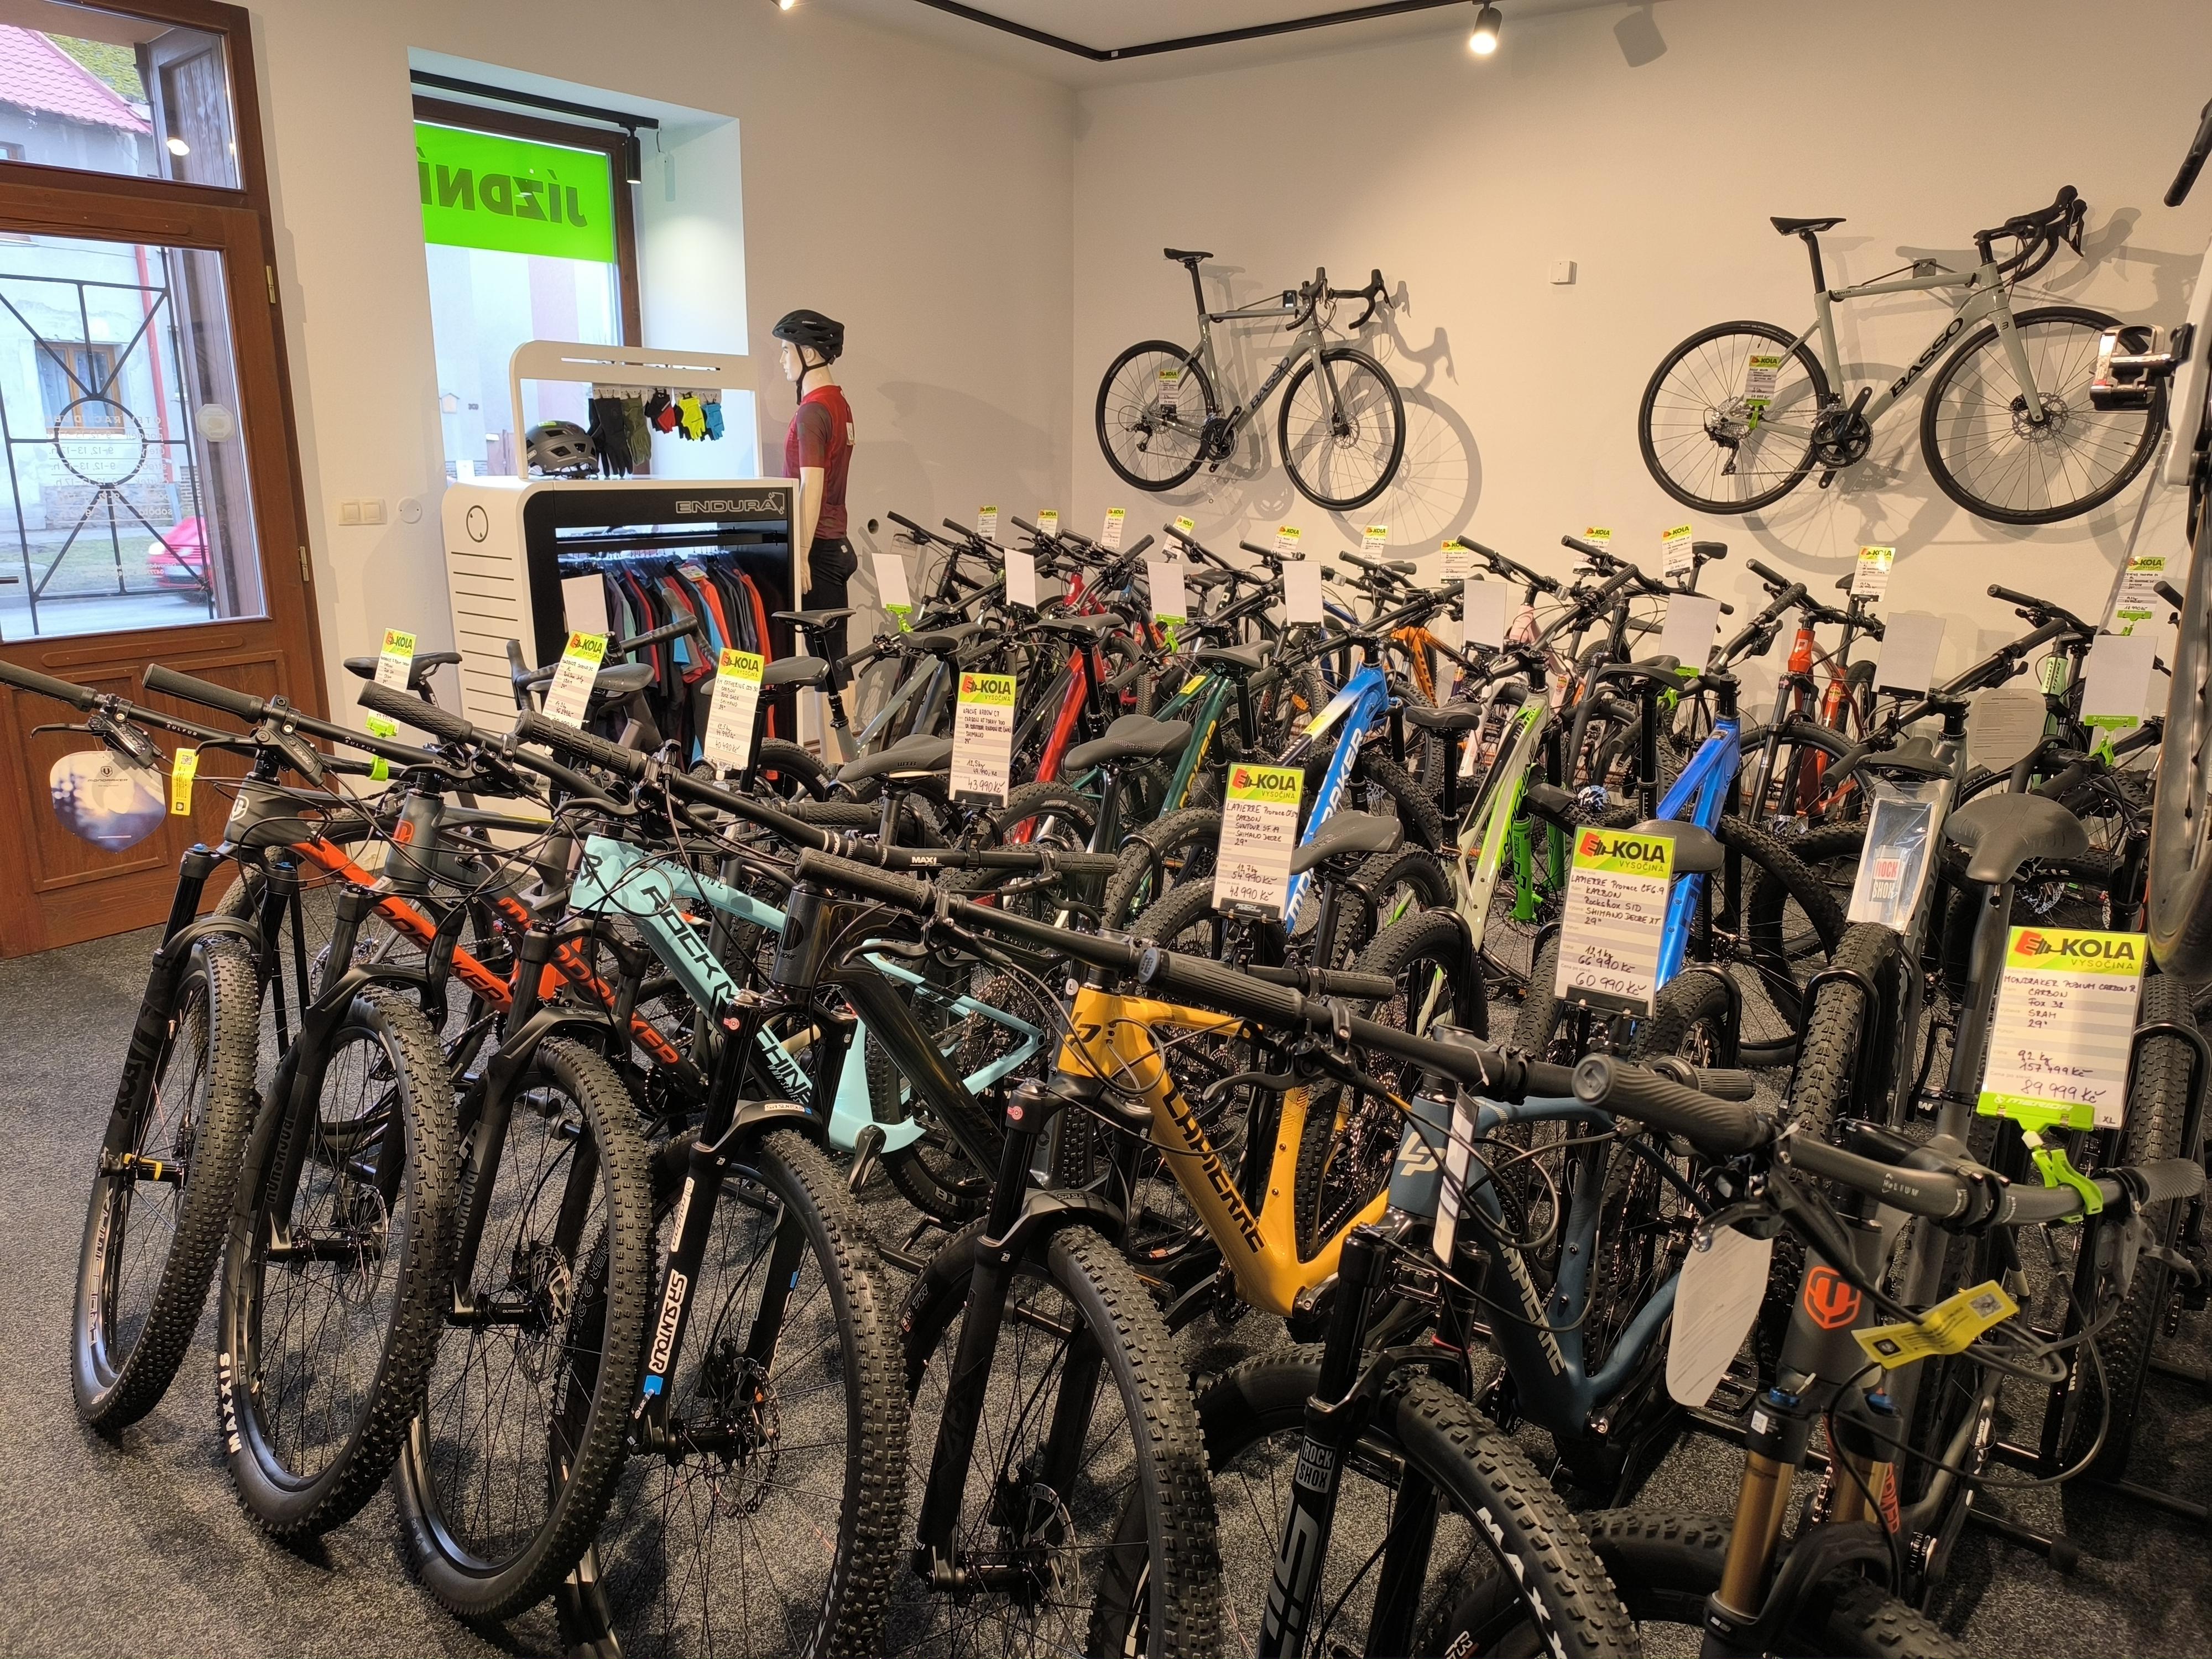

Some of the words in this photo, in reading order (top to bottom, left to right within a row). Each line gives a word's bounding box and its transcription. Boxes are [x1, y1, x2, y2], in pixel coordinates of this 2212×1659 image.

[1888, 317, 1964, 399] BASSO
[1249, 356, 1290, 410] BASSO
[675, 499, 775, 514] ENDURA
[980, 780, 993, 793] 990
[1261, 790, 1295, 800] VYSOČINA
[1226, 802, 1261, 814] LAPIERRE
[1264, 806, 1285, 816] Prorace
[1235, 813, 1261, 823] CARBON
[1234, 822, 1260, 831] SUNTOUR
[1235, 831, 1261, 841] SHIMANO
[911, 856, 937, 865] MAX1
[1619, 860, 1664, 873] VYSOČINA
[1231, 871, 1243, 880] 54
[1244, 873, 1261, 884] 990
[1571, 874, 1608, 888] LAPIERRE
[1611, 880, 1638, 892] Prorace
[1229, 885, 1239, 898] 48
[1240, 887, 1258, 900] 990
[1259, 890, 1274, 901] Kč
[1585, 887, 1622, 899] KARBON
[1584, 895, 1621, 910] Rockshox
[1625, 902, 1642, 912] SID
[1584, 917, 1602, 926] 29"
[1586, 907, 1623, 920] SHIMANO
[1625, 912, 1647, 925] DEORE
[1650, 917, 1661, 926] XT
[641, 886, 722, 980] ROCK
[1585, 945, 1603, 958] 12,1
[1578, 955, 1592, 966] 66
[1595, 957, 1619, 971] 990
[1620, 964, 1635, 974] Kč
[2071, 958, 2133, 970] VYSOČINA
[1575, 972, 1596, 987] 60
[1600, 977, 1624, 993] 990
[1626, 980, 1647, 996] Kč
[2003, 975, 2058, 988] MONDRAKER
[2063, 980, 2096, 990] PODIUM
[2098, 983, 2127, 992] CARBON
[2028, 989, 2068, 998] CARBON
[2028, 998, 2046, 1008] Fox
[2028, 1009, 2057, 1019] SRAM
[2018, 1062, 2042, 1072] 157
[2021, 1078, 2043, 1095] 89
[2049, 1083, 2078, 1100] 999
[2081, 1087, 2107, 1104] Kč
[2006, 1097, 2074, 1112] MERIDA
[2103, 1116, 2116, 1124] XL
[1162, 1088, 1266, 1254] LAPIERRE
[912, 1283, 928, 1310] TR
[219, 1352, 243, 1454] MAXXIS
[1302, 1439, 1333, 1468] ROCK
[1298, 1463, 1327, 1489] SHOX
